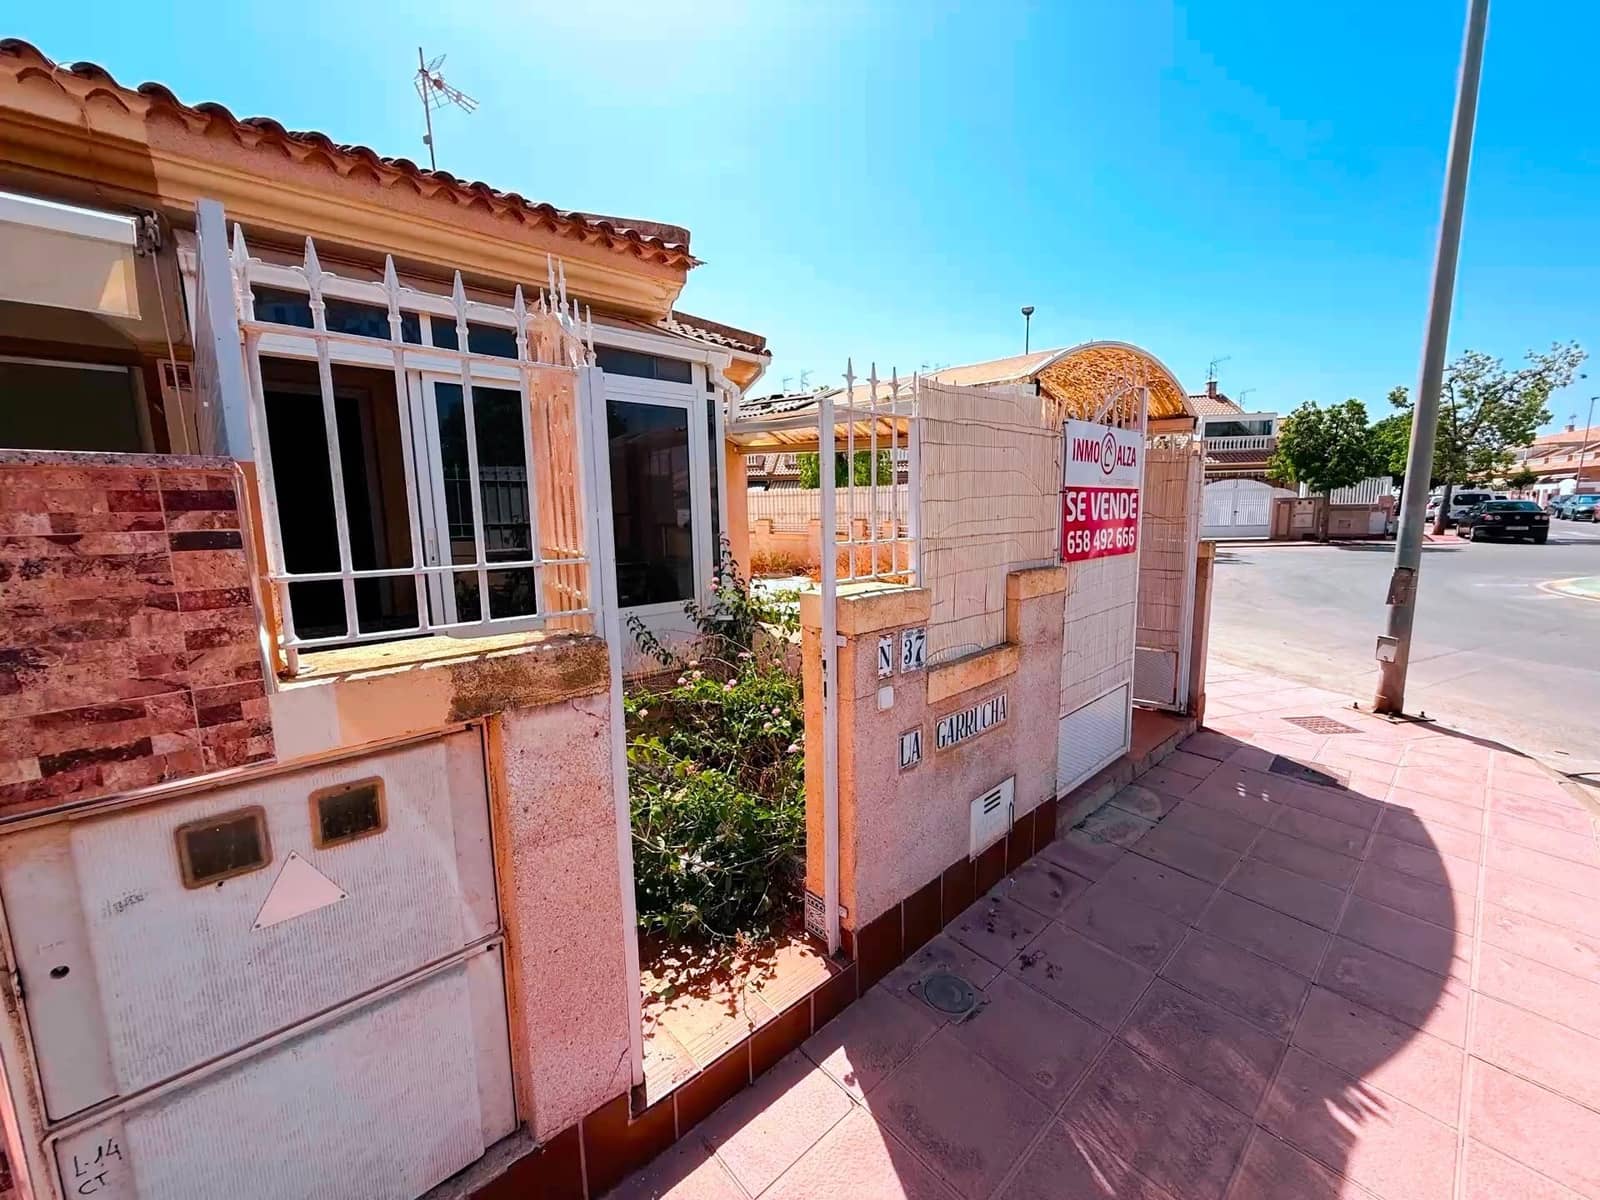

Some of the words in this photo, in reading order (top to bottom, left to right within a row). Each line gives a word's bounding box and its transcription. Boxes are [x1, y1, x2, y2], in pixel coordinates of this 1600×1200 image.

[1072, 438, 1100, 463] INMO
[1116, 445, 1136, 467] ALZA
[1066, 491, 1086, 522] SE
[1090, 492, 1137, 521] VENDE
[1067, 530, 1091, 554] 658
[1093, 529, 1113, 550] 492
[1116, 527, 1135, 547] 666
[879, 644, 891, 670] N
[904, 634, 925, 665] 37
[900, 731, 921, 767] LA
[936, 695, 1006, 749] GARRUCHA
